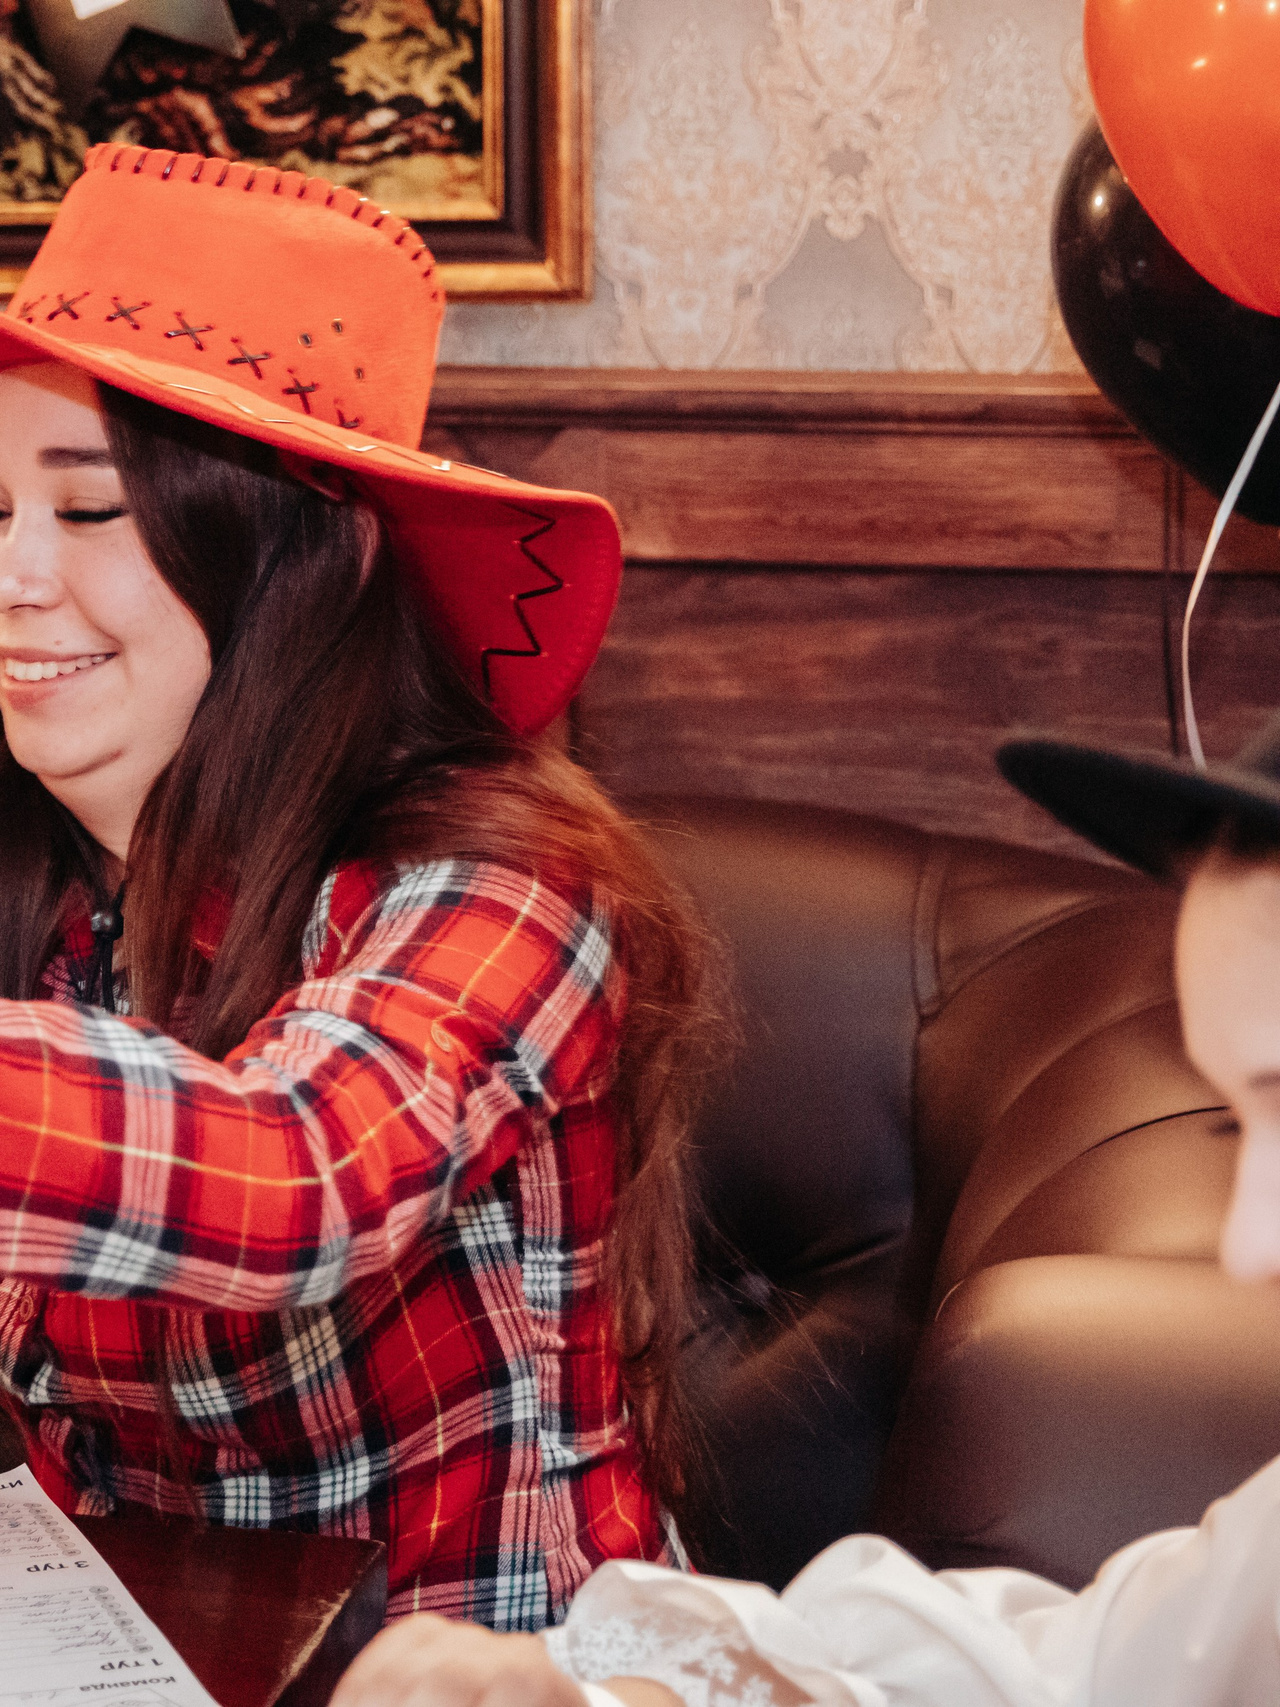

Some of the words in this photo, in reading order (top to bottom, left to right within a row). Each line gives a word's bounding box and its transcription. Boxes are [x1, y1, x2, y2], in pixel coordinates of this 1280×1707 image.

[26, 1562, 69, 1572] тур
[100, 1660, 144, 1670] тур
[151, 1657, 163, 1666] 1
[80, 1675, 176, 1692] Команда
